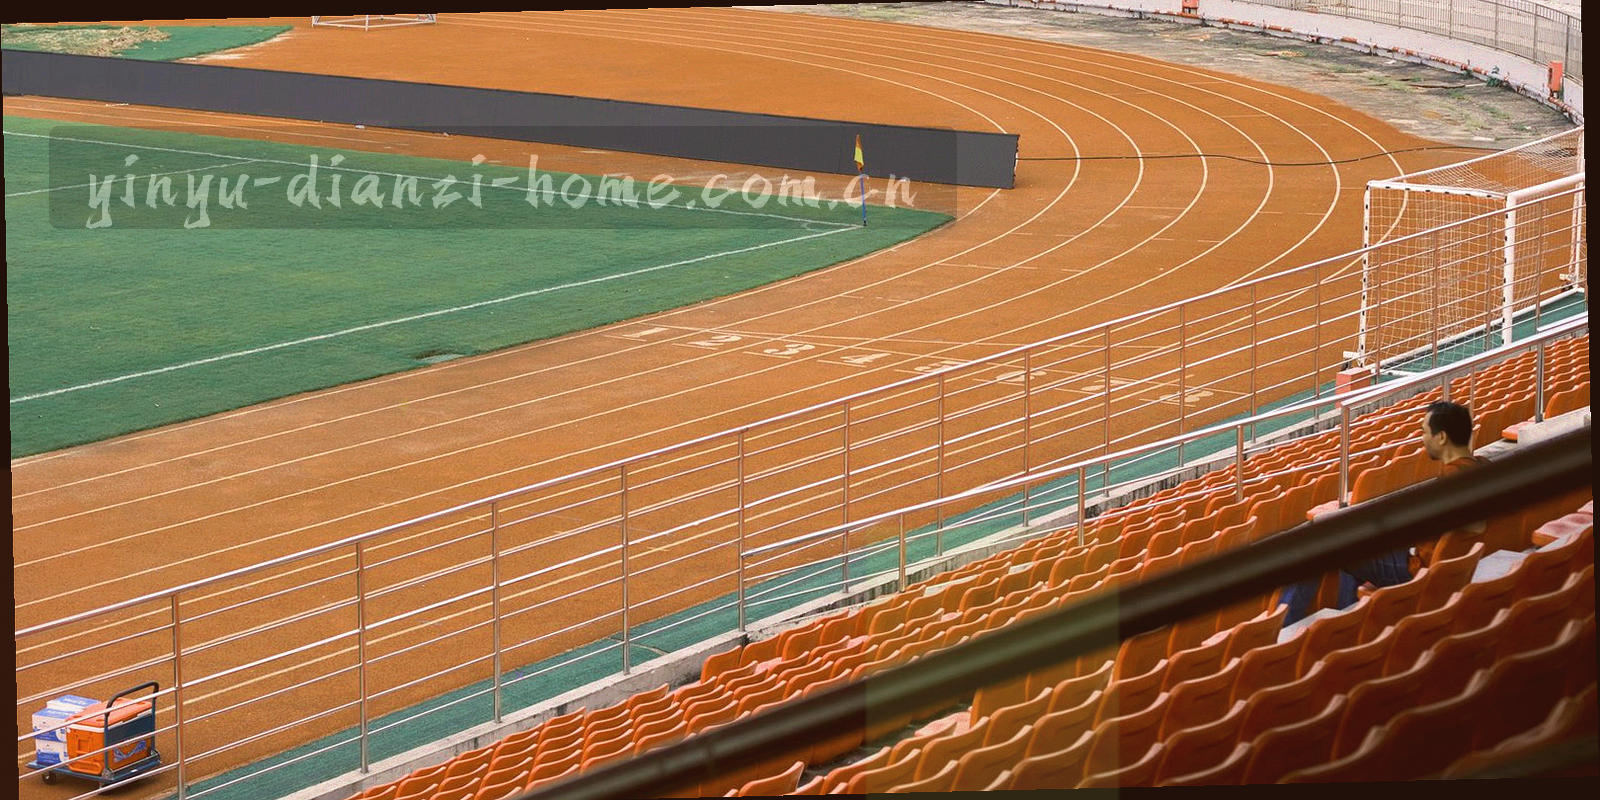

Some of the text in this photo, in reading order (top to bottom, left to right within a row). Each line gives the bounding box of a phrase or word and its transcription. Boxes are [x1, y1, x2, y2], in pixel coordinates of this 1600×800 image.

[622, 326, 669, 338] 1
[687, 334, 742, 347] 2
[763, 344, 815, 356] 3
[840, 352, 892, 365] 4
